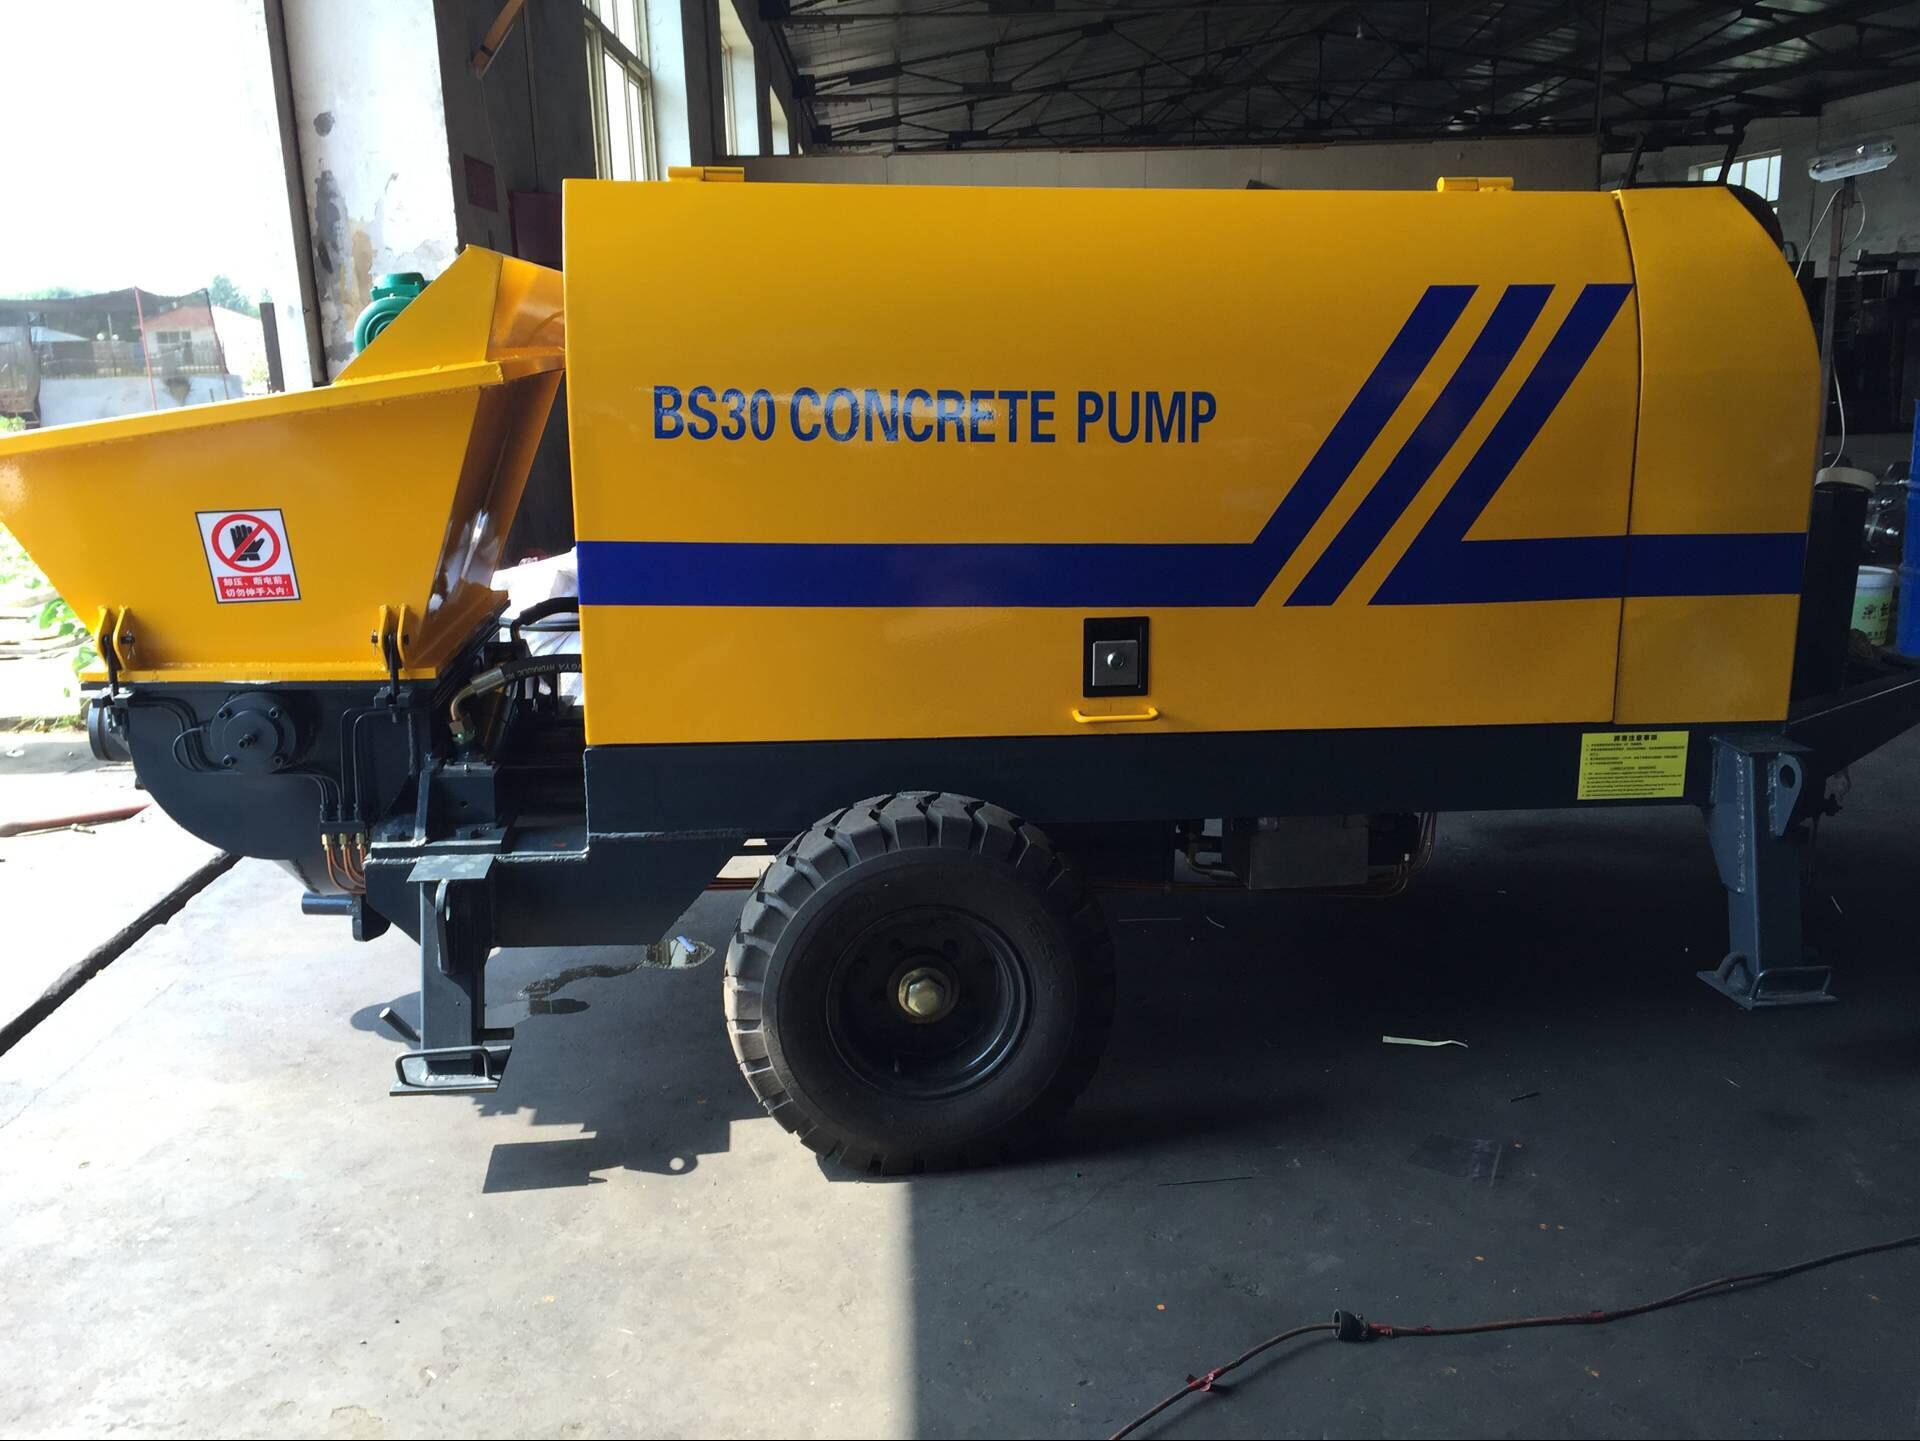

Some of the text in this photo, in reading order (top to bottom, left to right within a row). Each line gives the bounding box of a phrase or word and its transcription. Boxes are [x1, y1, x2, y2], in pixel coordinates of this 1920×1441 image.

[654, 386, 1216, 442] BS30 CONCRETE PUMP
